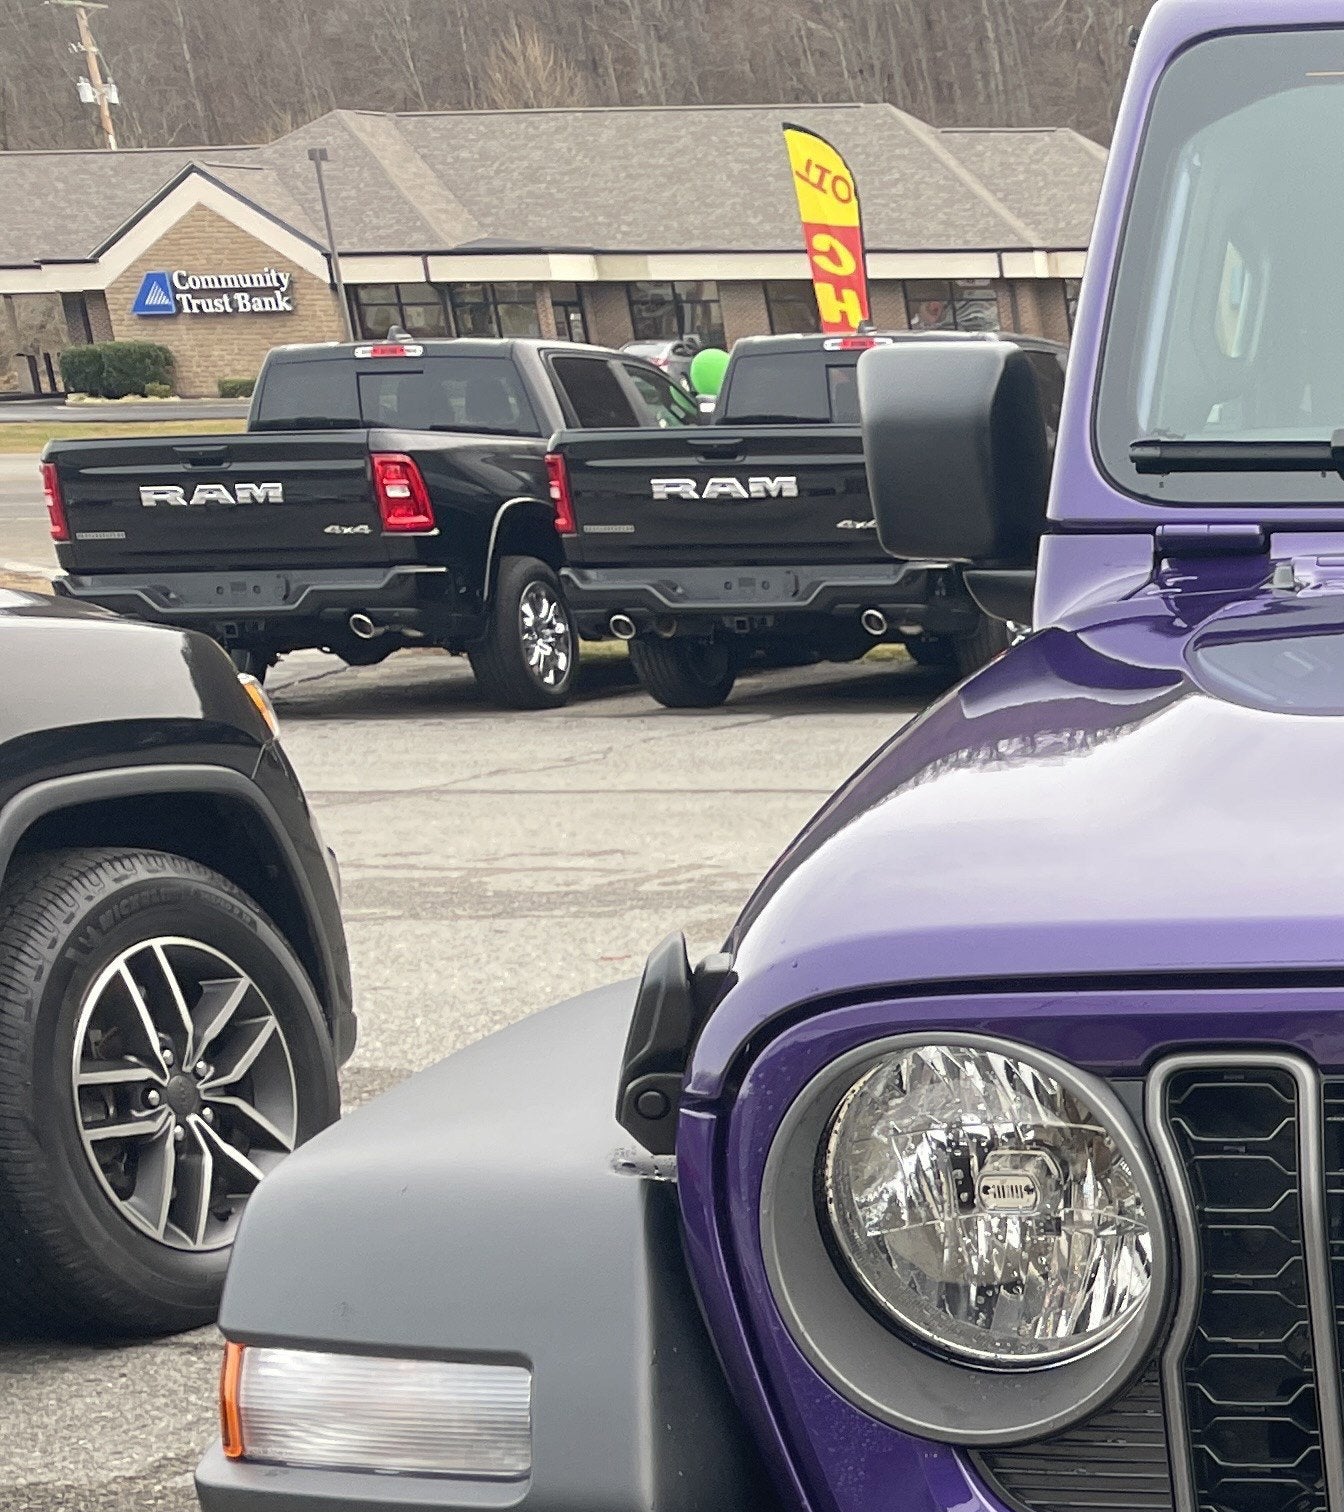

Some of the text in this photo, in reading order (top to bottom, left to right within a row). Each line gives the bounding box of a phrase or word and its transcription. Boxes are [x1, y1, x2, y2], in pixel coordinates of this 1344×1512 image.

[172, 267, 291, 292] Community
[176, 290, 293, 314] Trust Bank
[139, 482, 284, 507] RAM
[650, 476, 799, 501] RAM
[323, 523, 372, 535] 4x4
